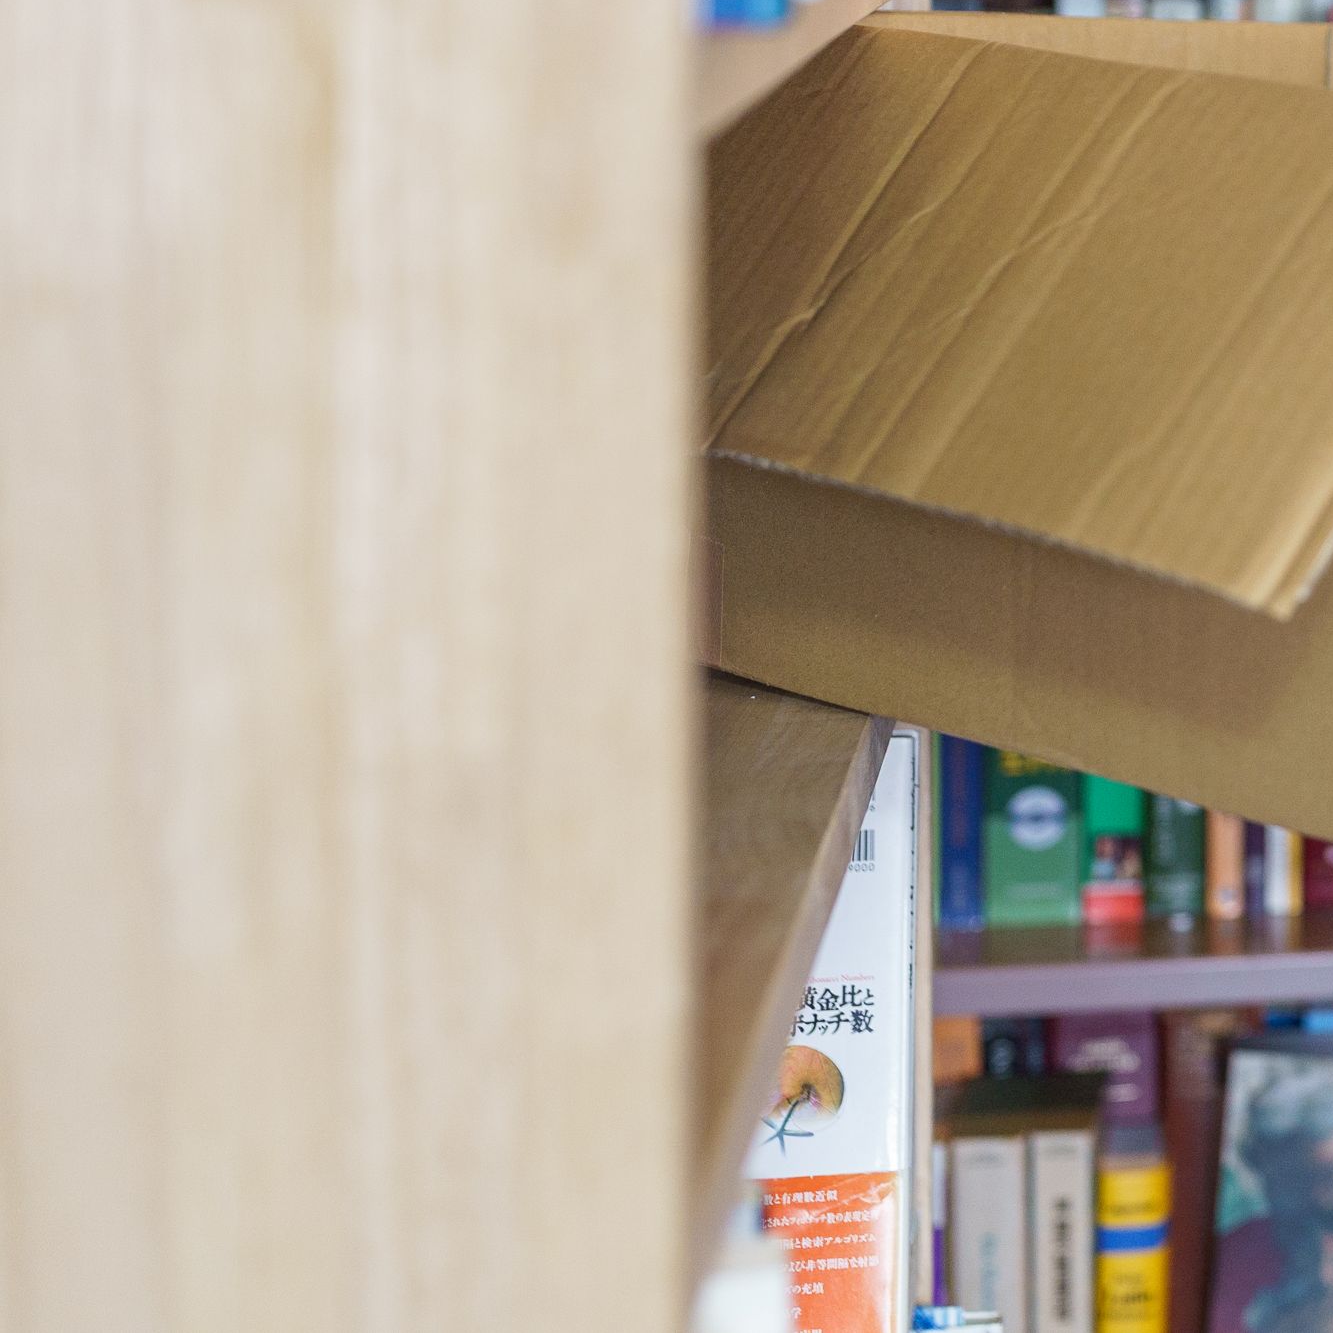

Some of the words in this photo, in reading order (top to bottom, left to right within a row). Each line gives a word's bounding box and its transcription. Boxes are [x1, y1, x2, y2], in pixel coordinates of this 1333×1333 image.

[784, 1254, 880, 1273] よび非等間隔な射影
